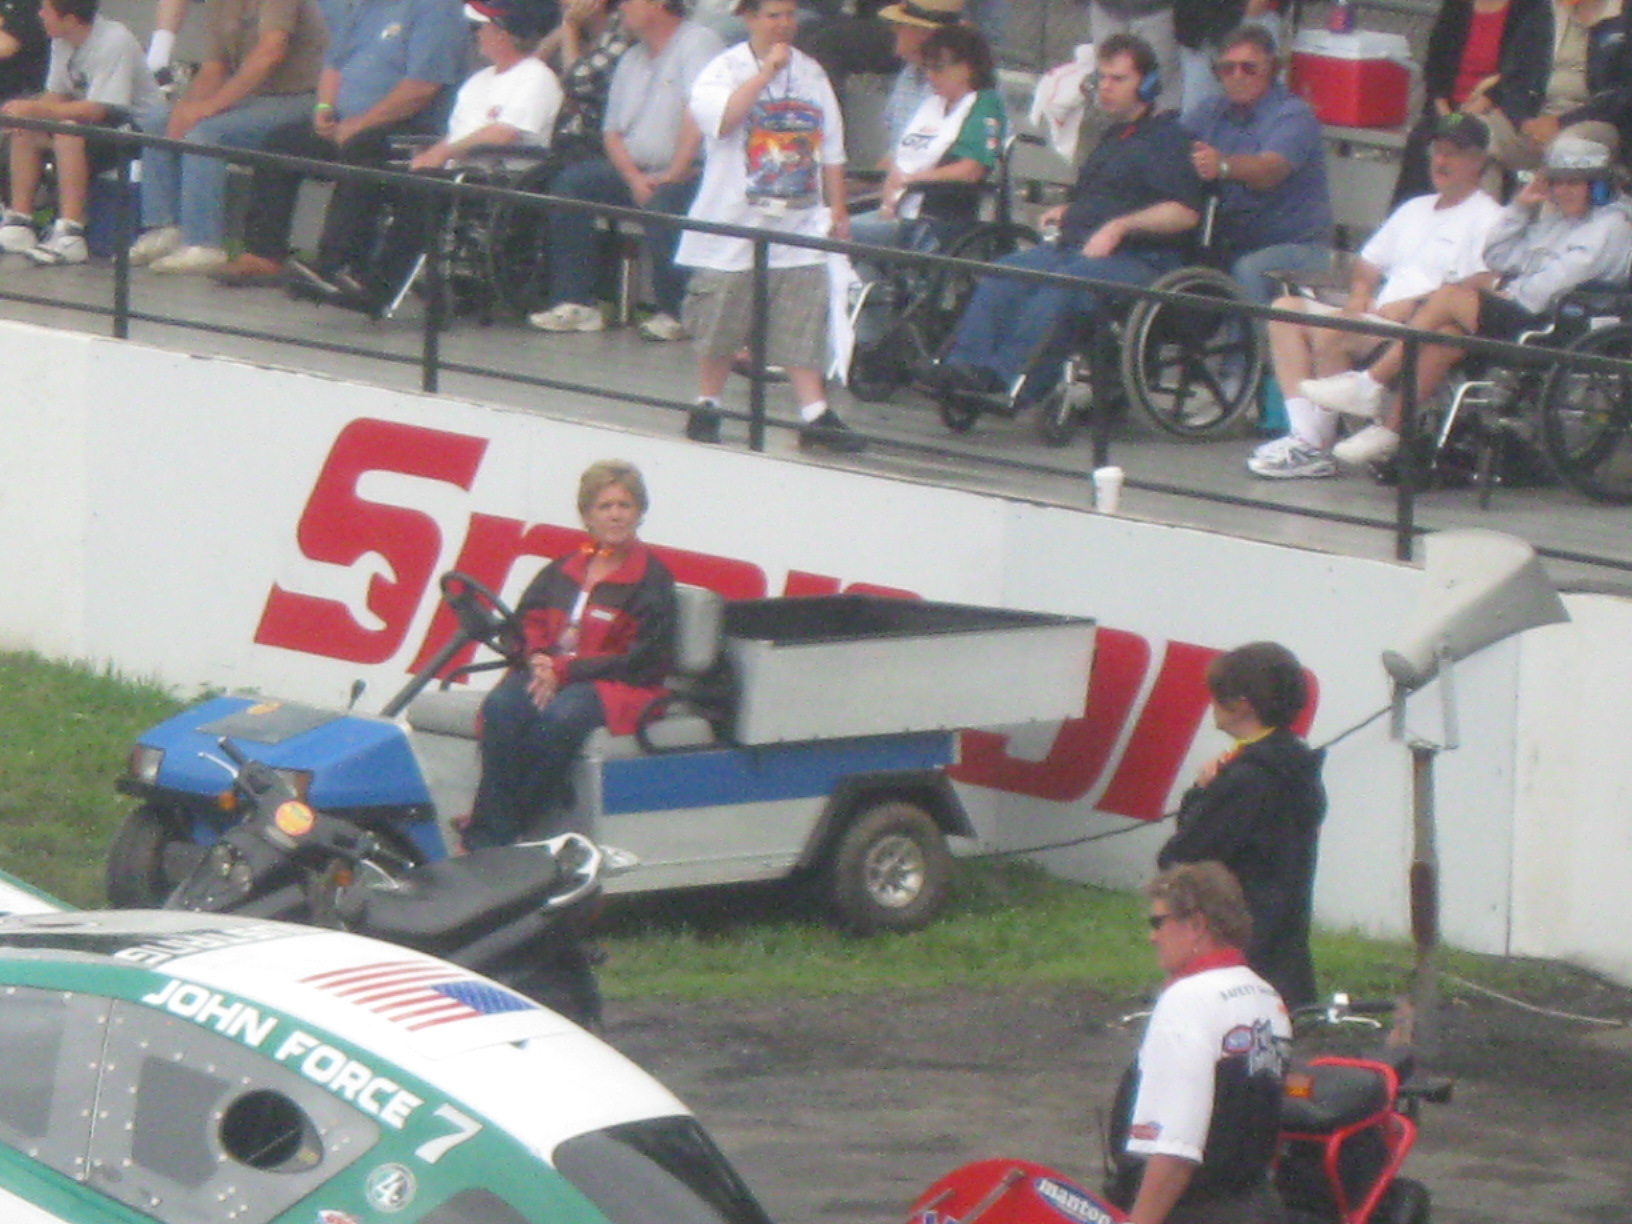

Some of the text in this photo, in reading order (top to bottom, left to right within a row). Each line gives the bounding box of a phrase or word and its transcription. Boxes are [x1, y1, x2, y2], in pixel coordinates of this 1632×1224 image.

[142, 977, 483, 1165] JOHN FORCE 7
